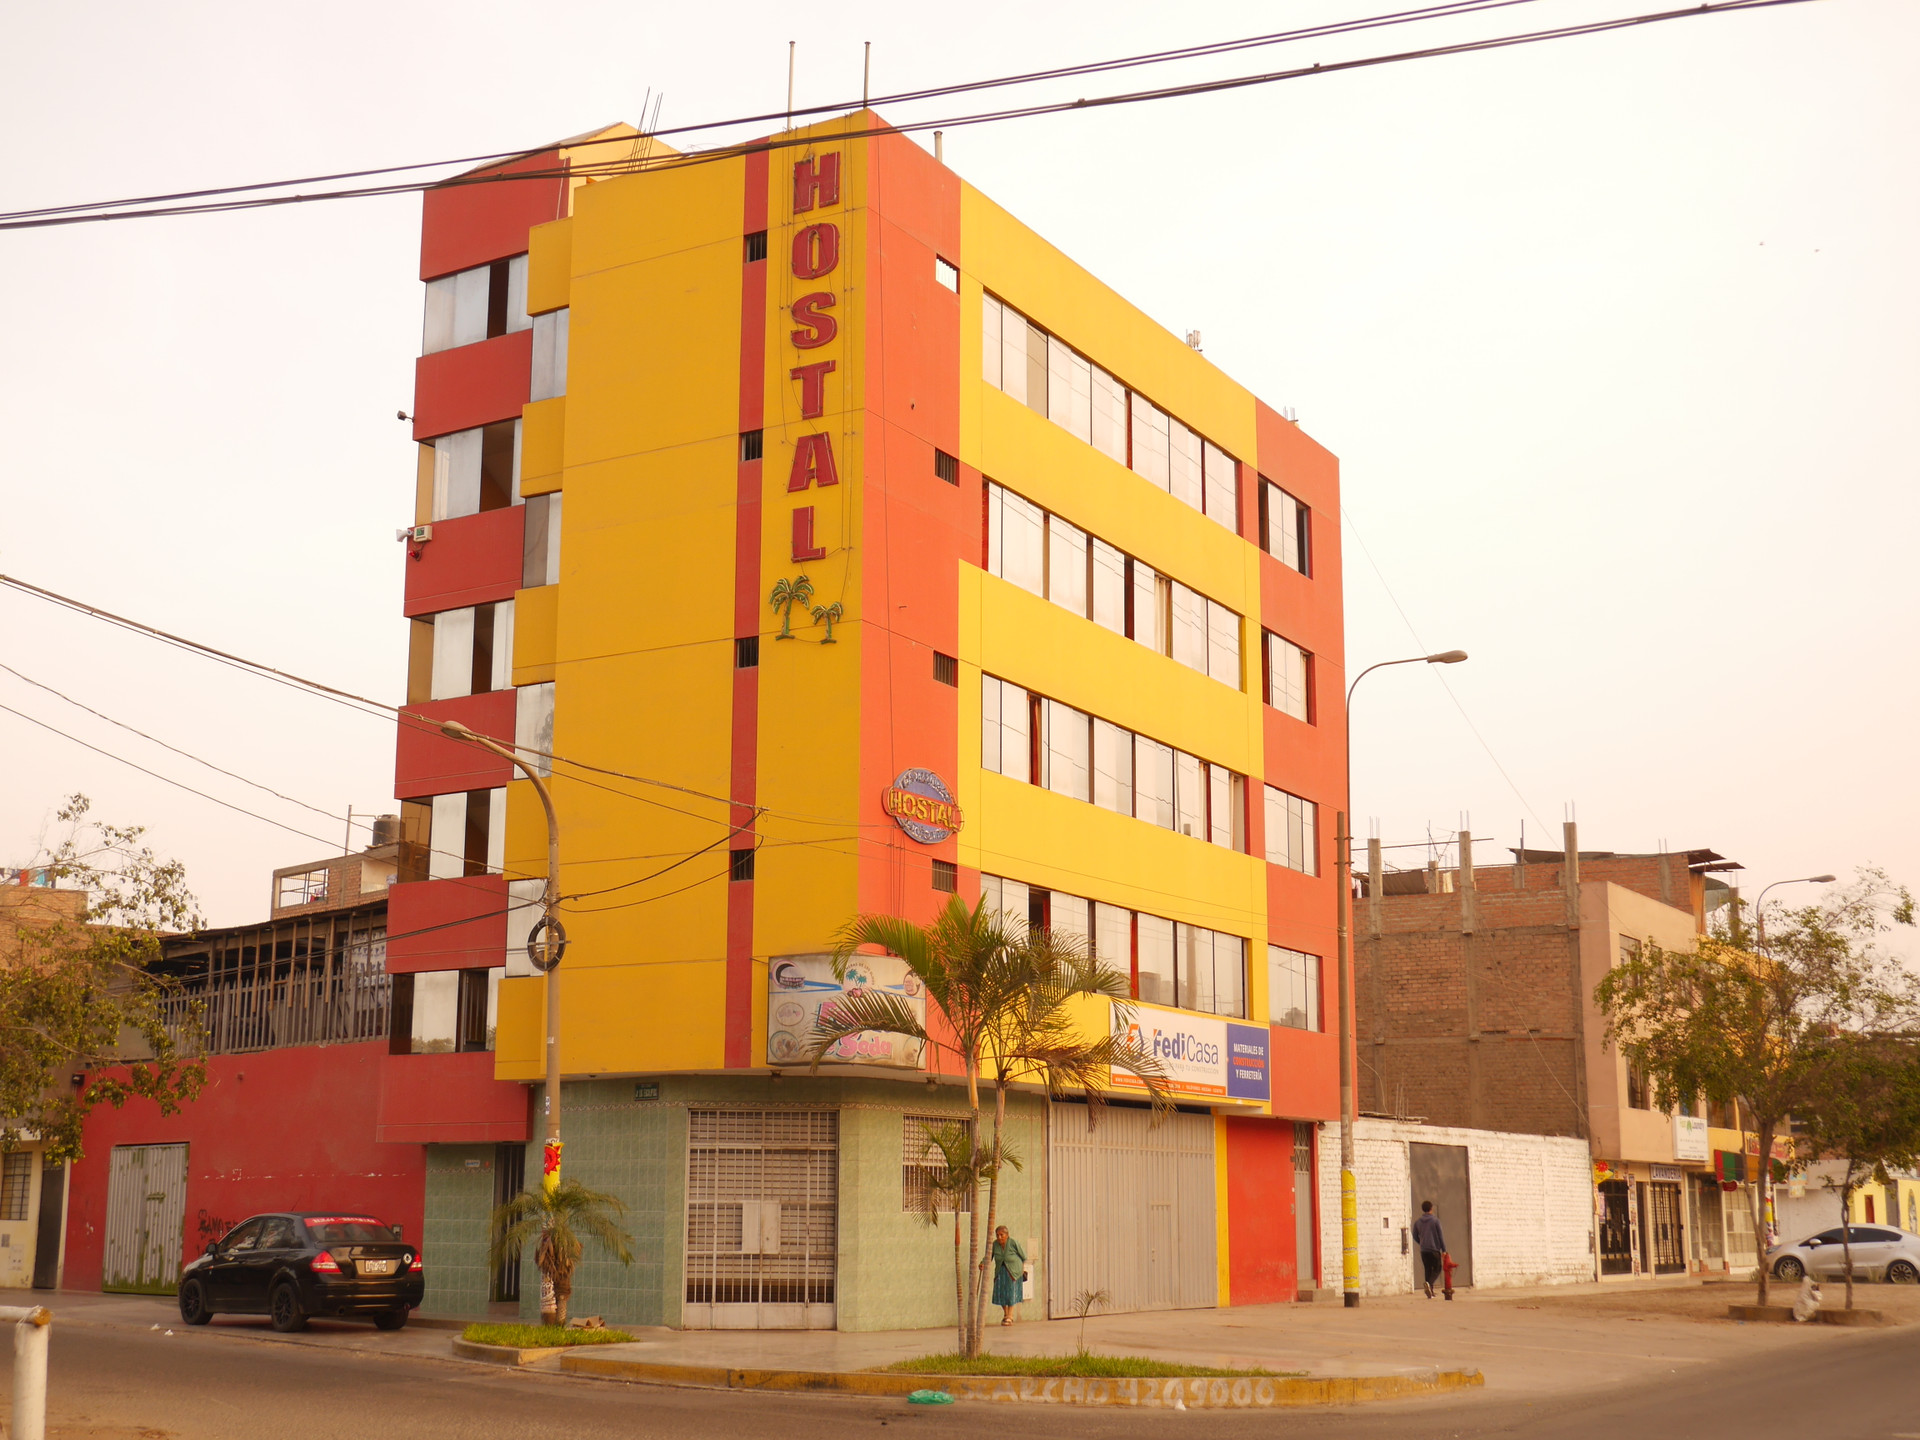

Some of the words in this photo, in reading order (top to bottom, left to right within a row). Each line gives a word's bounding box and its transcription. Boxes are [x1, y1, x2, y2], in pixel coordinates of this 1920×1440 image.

[787, 151, 840, 563] HOSTAL
[889, 789, 958, 829] HOSTAL
[836, 1031, 892, 1057] Soda
[1233, 1043, 1258, 1055] MATERIALES
[1258, 1046, 1264, 1056] DE
